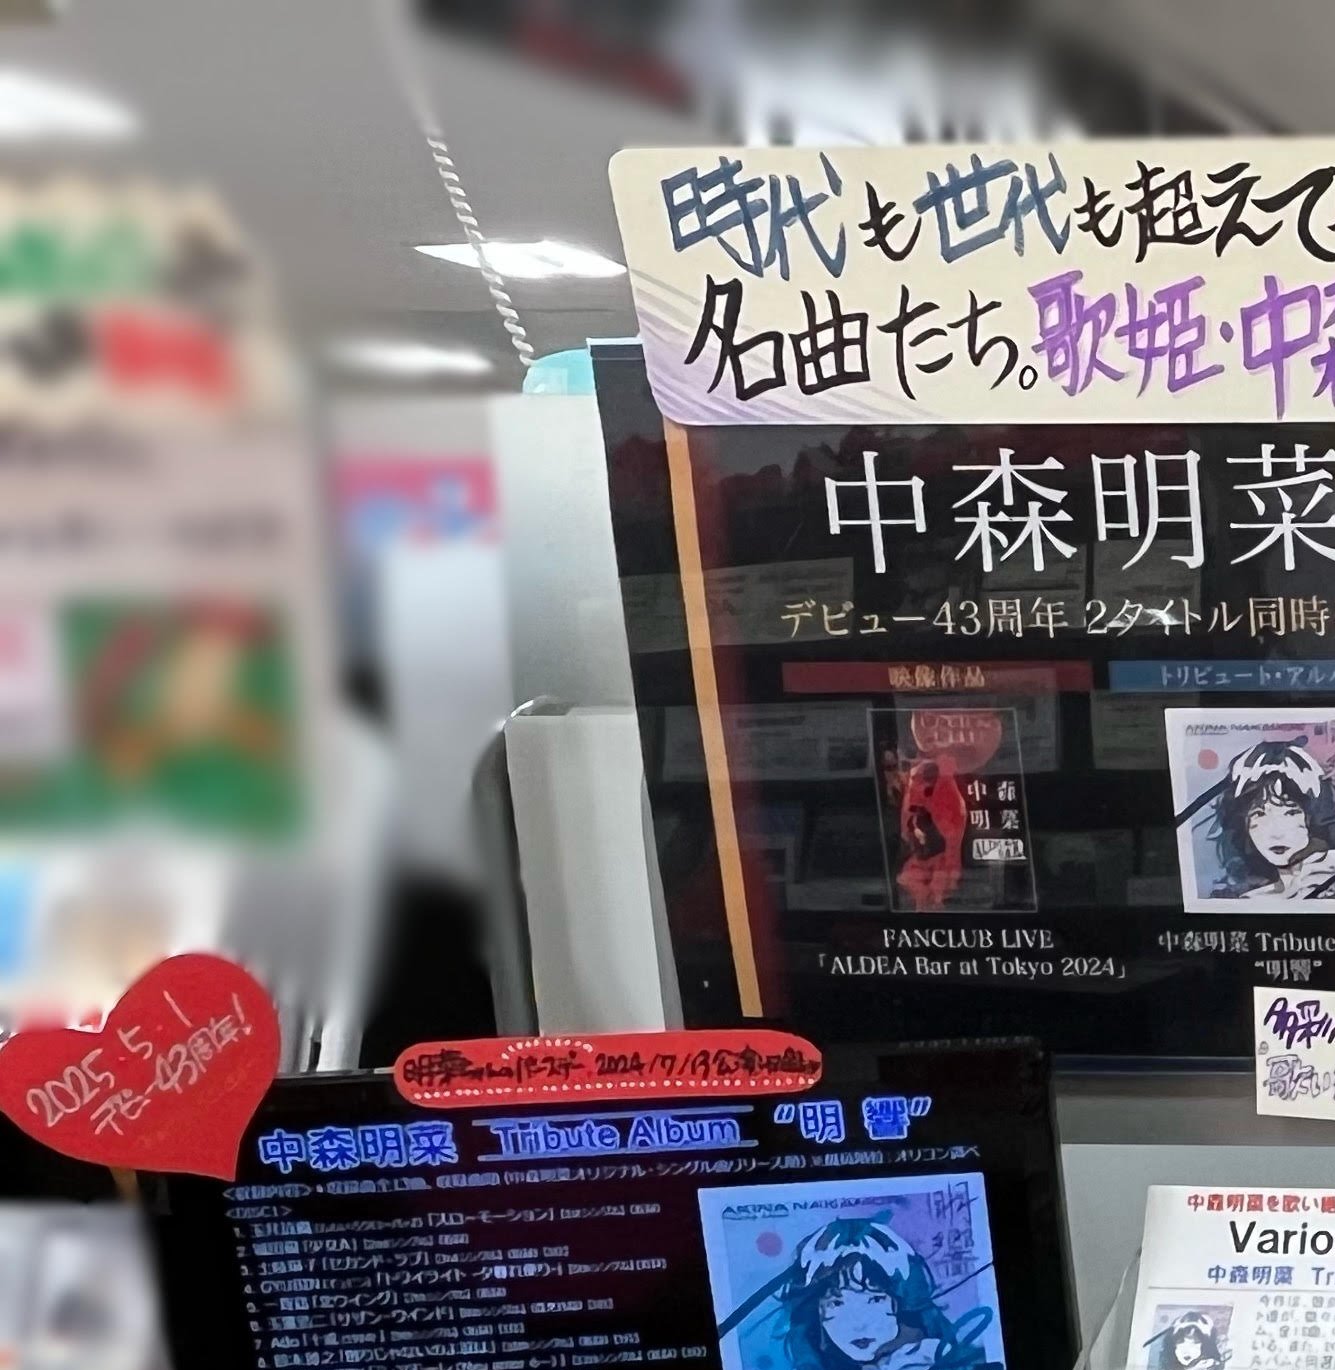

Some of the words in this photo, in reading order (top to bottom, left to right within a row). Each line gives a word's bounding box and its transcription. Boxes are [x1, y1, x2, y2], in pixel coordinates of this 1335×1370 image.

[780, 598, 1070, 640] デビュー43周年
[887, 666, 986, 689] 映像作品
[882, 929, 995, 949] FANCLUB
[1003, 929, 1054, 949] LIVE
[916, 956, 952, 976] Bar
[989, 955, 1053, 978] Tokyo
[258, 1119, 460, 1175] 中森明菜
[490, 1122, 622, 1156] Tribute
[627, 1114, 740, 1150] Album
